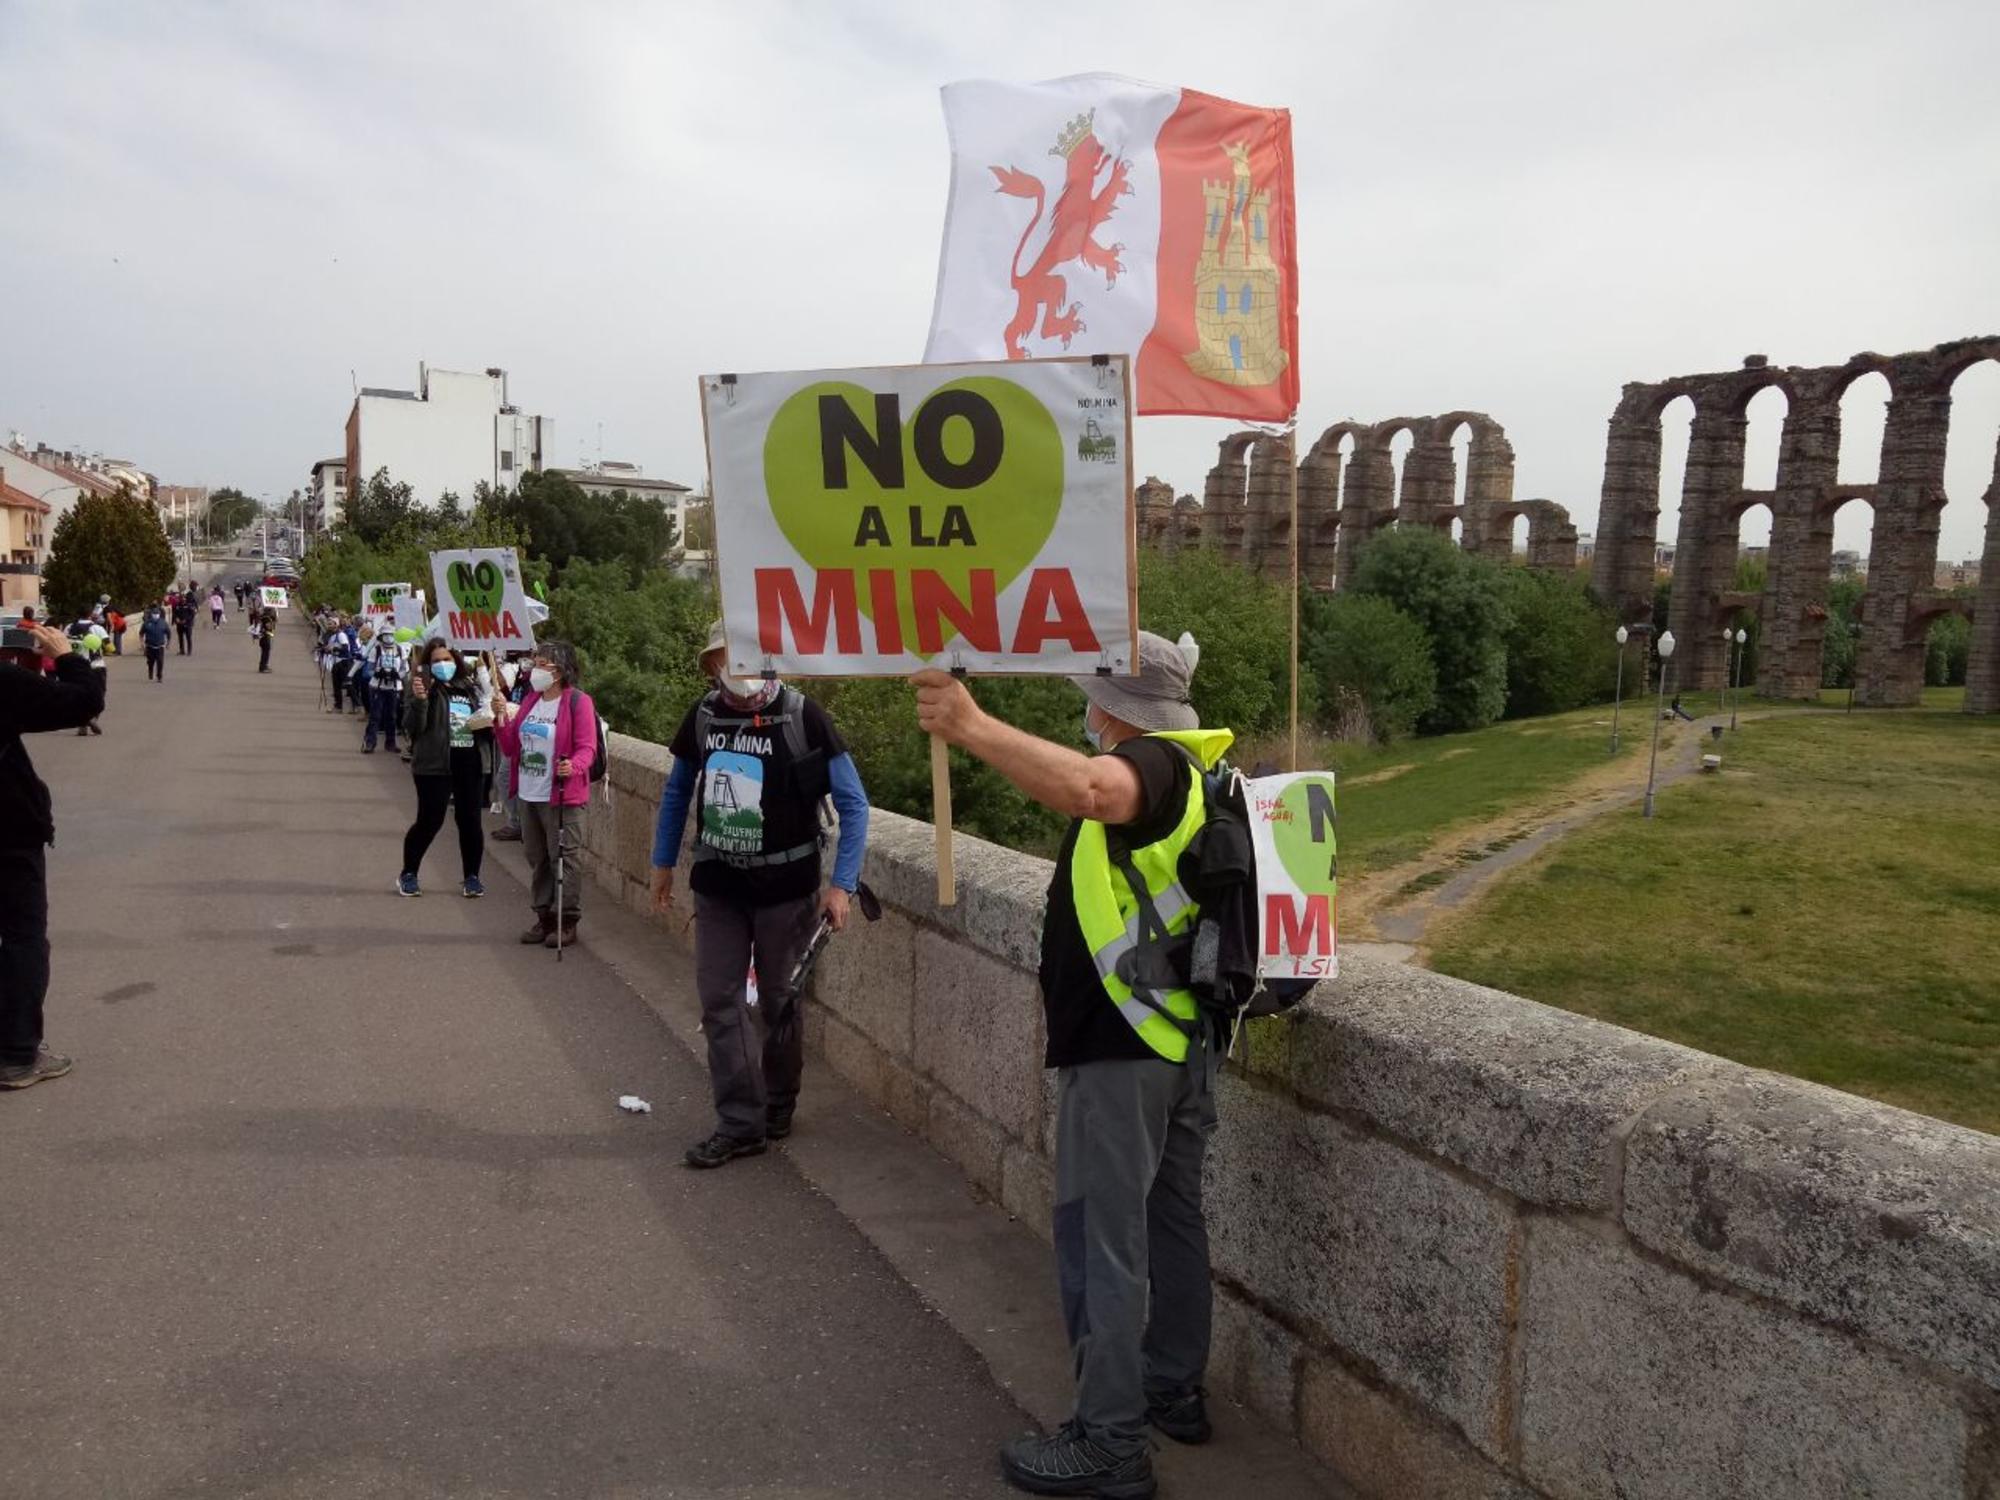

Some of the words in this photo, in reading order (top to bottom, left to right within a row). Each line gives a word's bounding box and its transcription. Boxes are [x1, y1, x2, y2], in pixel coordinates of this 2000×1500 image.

[818, 389, 1004, 490] NO
[854, 506, 891, 547] A
[909, 506, 976, 547] LA
[456, 562, 494, 591] NO
[463, 595, 473, 608] A
[755, 567, 1102, 656] MINA
[448, 610, 522, 640] MINA
[733, 734, 773, 756] MINA
